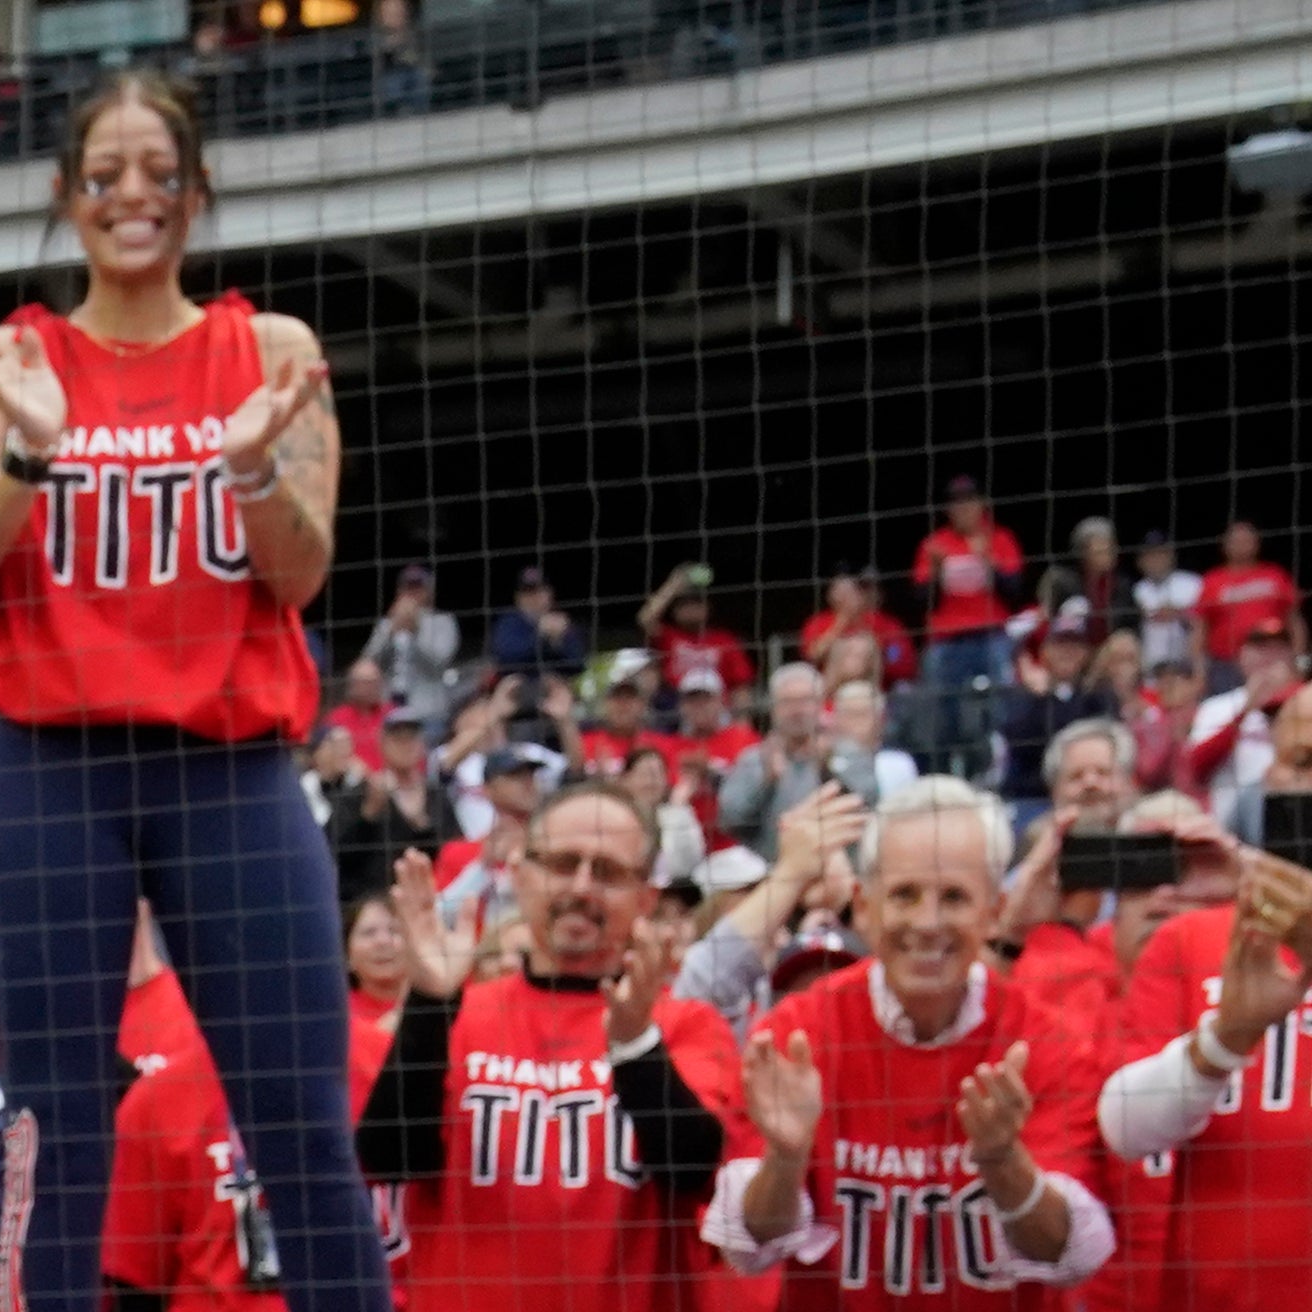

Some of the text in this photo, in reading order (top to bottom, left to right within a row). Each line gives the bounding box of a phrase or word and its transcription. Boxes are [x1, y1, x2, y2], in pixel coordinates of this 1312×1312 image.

[58, 415, 225, 458] HANK YO
[40, 460, 250, 590] TITO
[466, 1051, 583, 1091] THANK
[835, 1177, 1018, 1296] TITO
